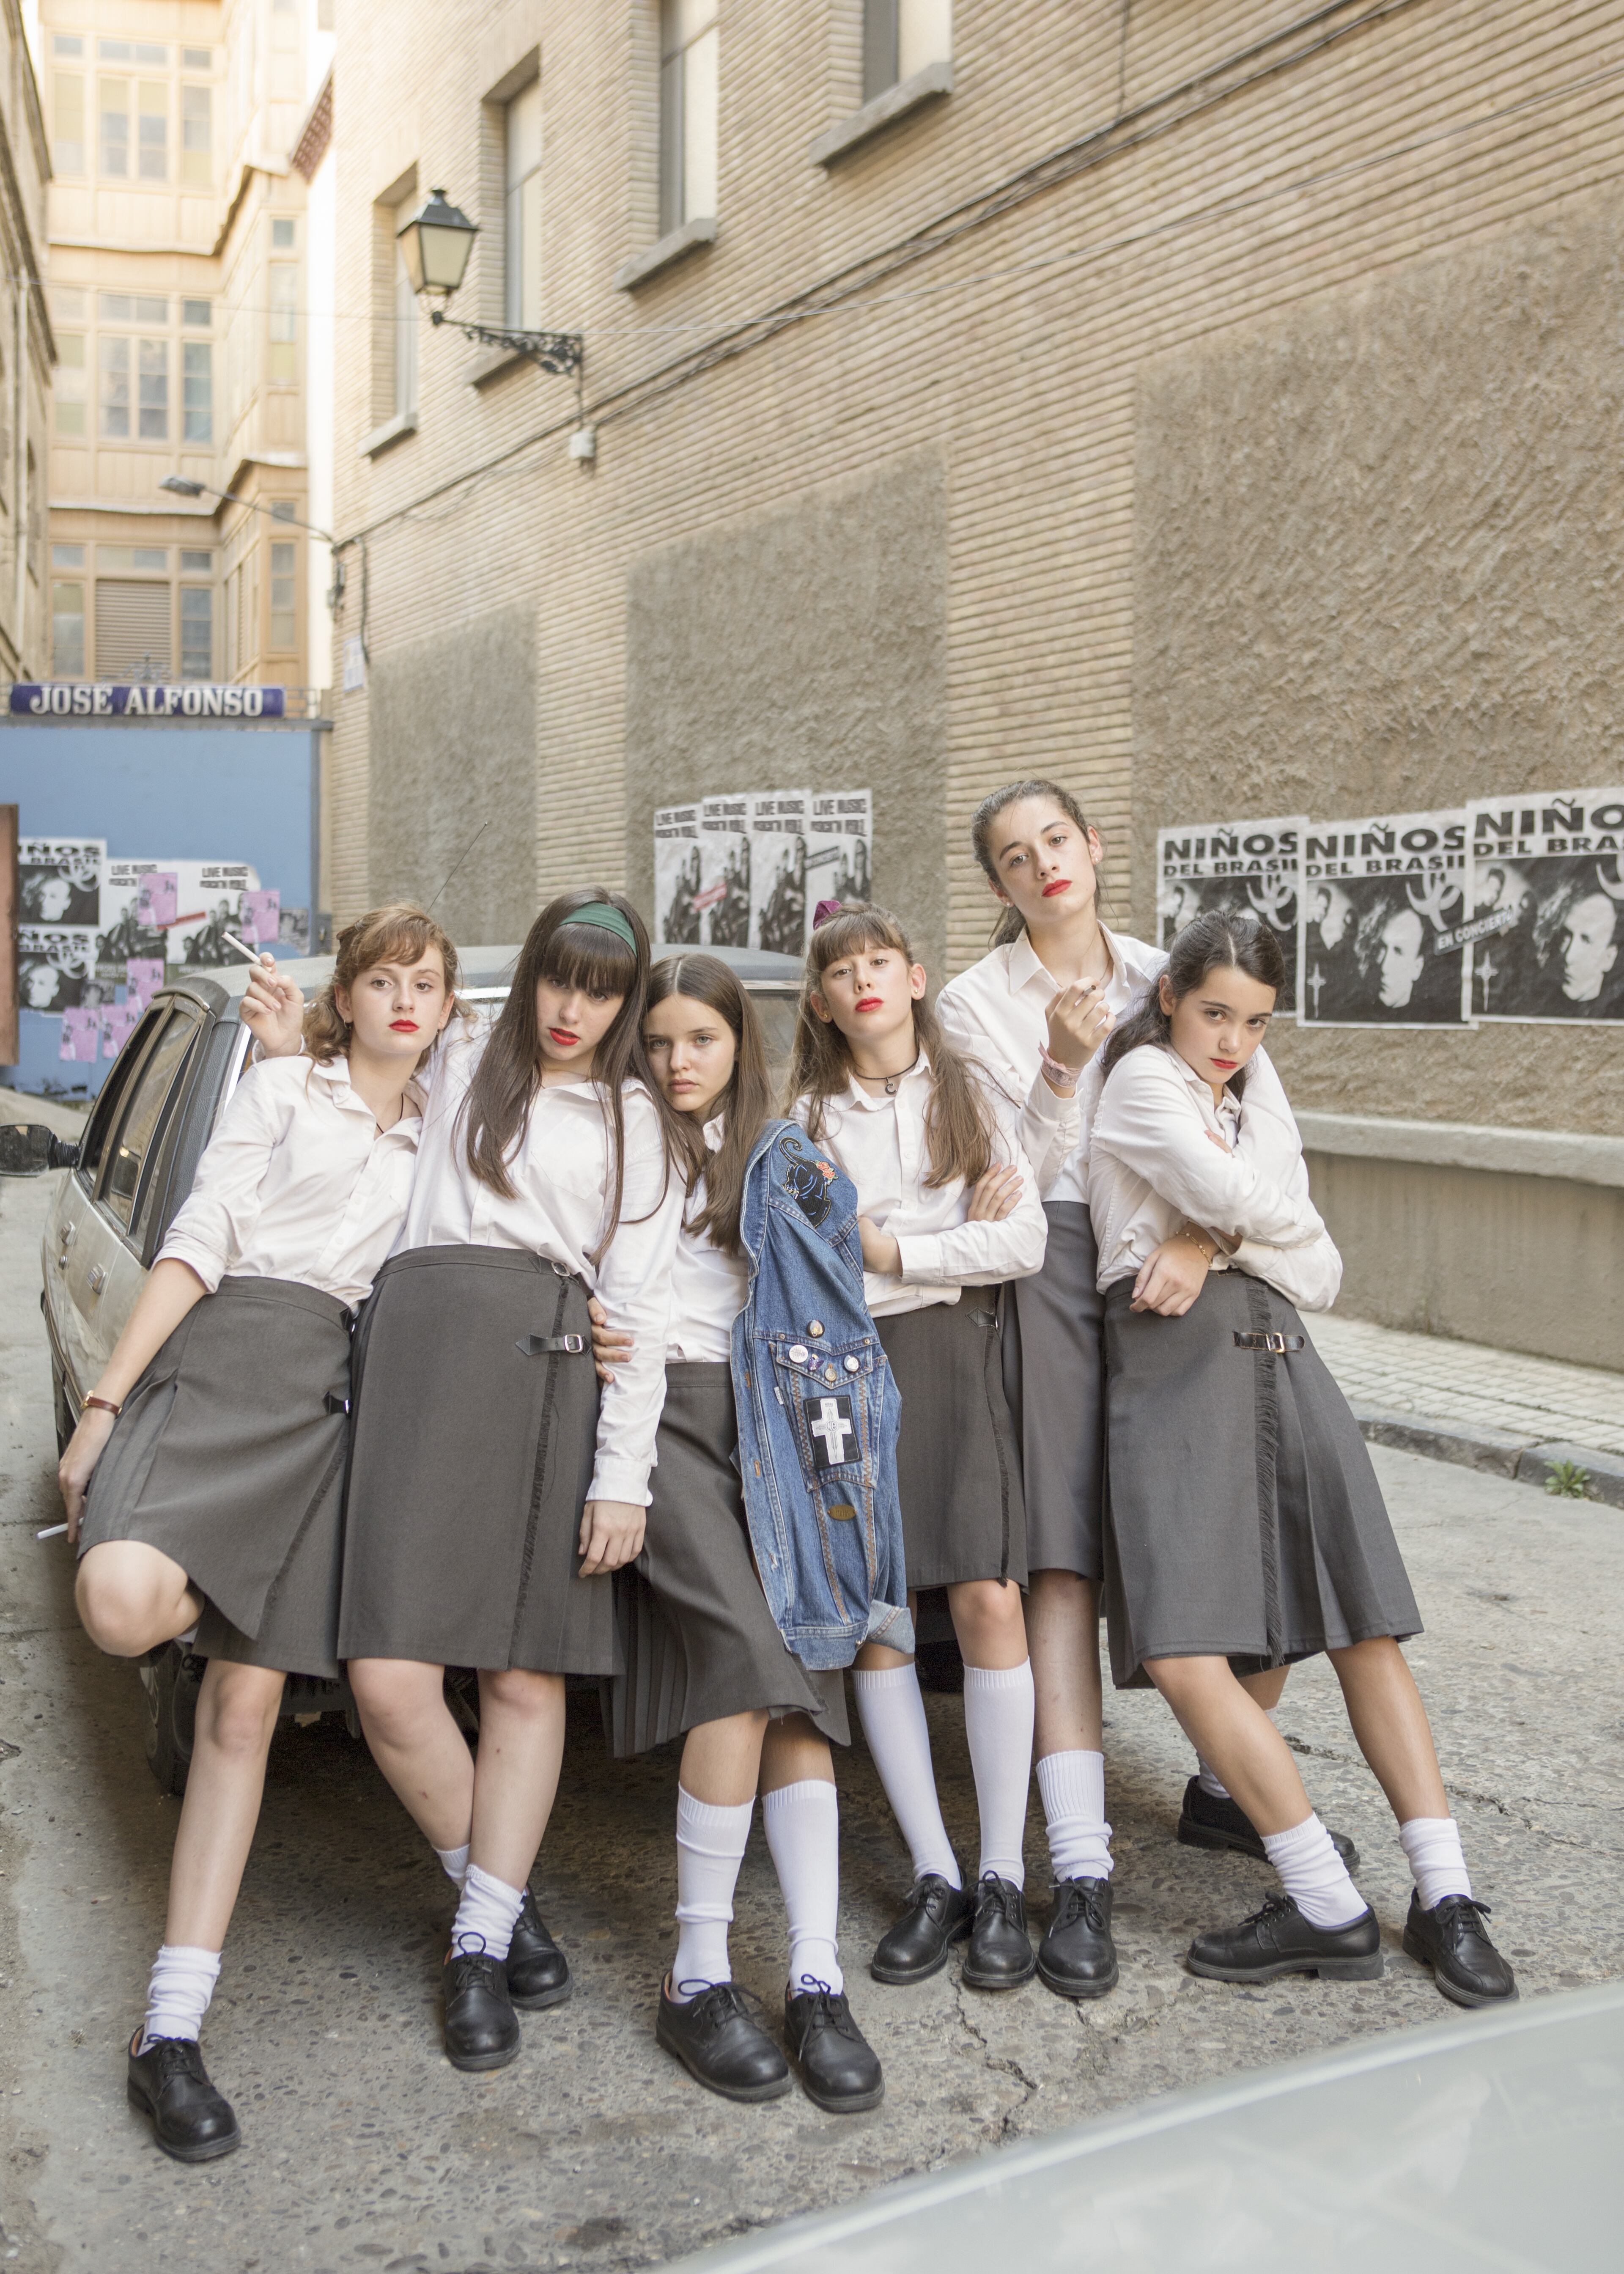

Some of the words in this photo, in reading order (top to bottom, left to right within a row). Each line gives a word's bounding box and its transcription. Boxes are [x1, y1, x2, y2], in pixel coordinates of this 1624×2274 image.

[124, 687, 263, 716] ALFONSO
[1164, 827, 1298, 861] NIÑOS
[1306, 823, 1465, 861] NIÑOS
[1474, 840, 1532, 857] DEL
[1164, 864, 1204, 877] DEL
[1306, 862, 1353, 879] DEL
[1437, 933, 1454, 950] EN
[1455, 909, 1513, 943] CONCIERTO
